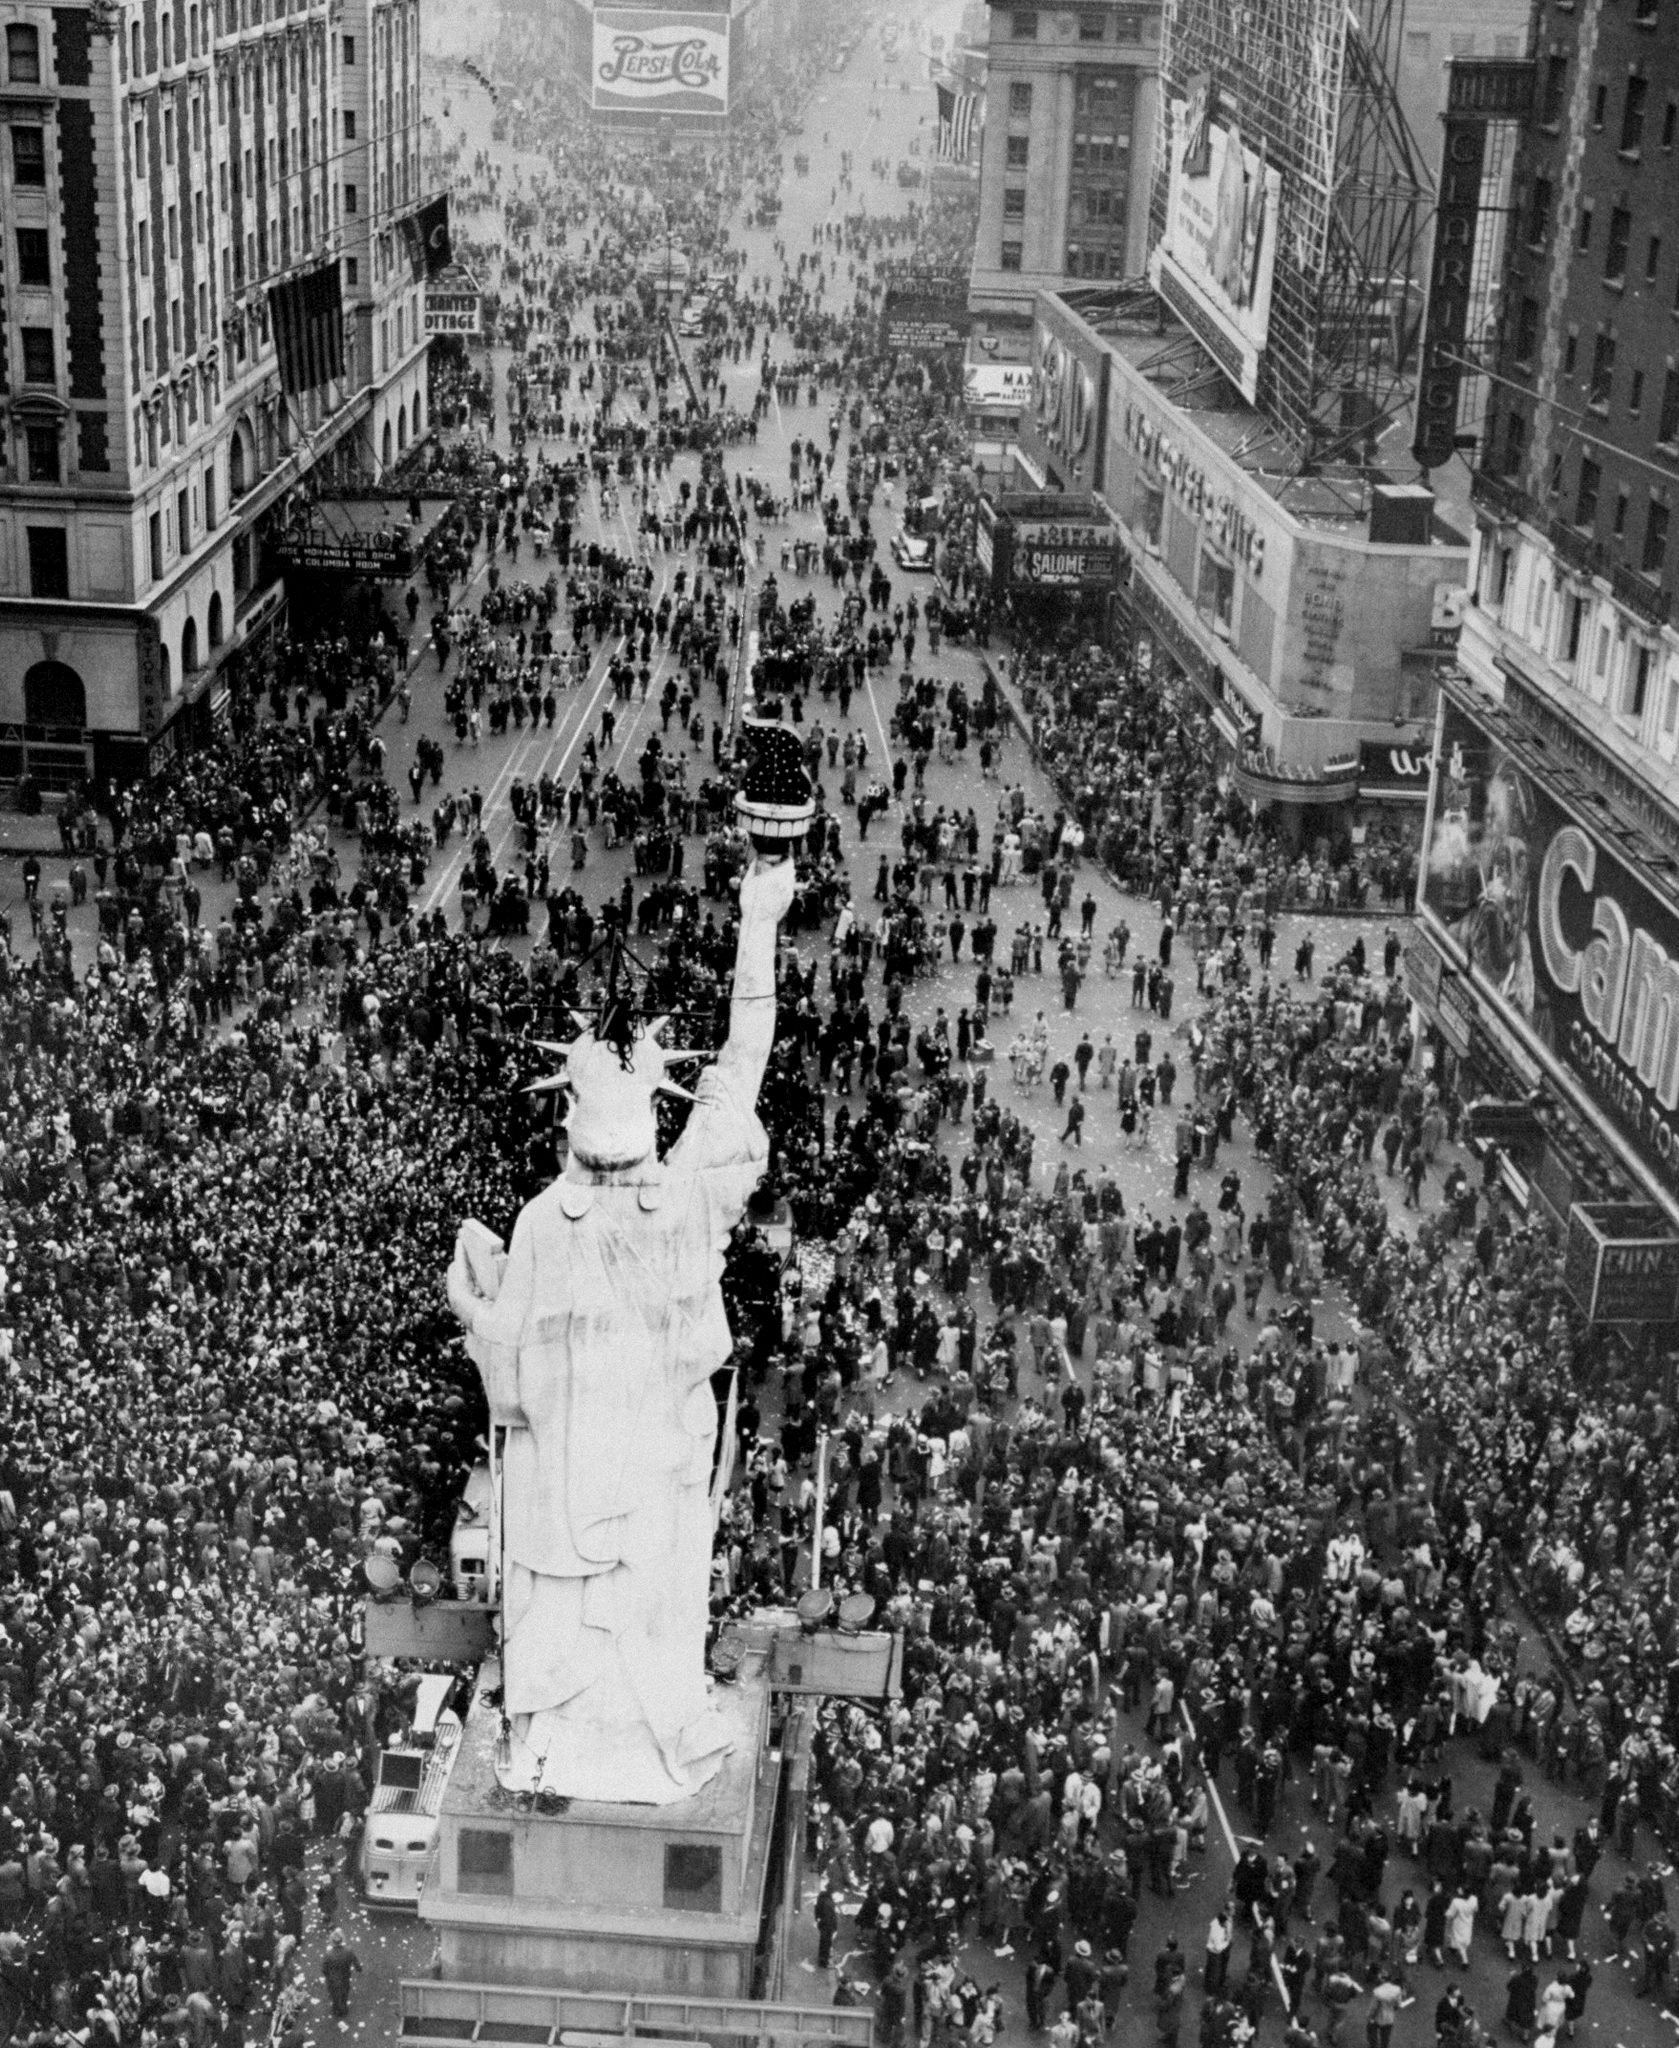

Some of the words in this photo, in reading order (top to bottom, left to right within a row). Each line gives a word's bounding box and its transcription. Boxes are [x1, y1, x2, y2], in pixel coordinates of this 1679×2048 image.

[1422, 132, 1475, 449] CLARIDGE
[276, 527, 326, 547] OTEL
[292, 557, 301, 565] IN
[305, 558, 351, 568] COLUMBIA
[355, 560, 381, 569] ROOM
[1032, 552, 1086, 578] SALOME
